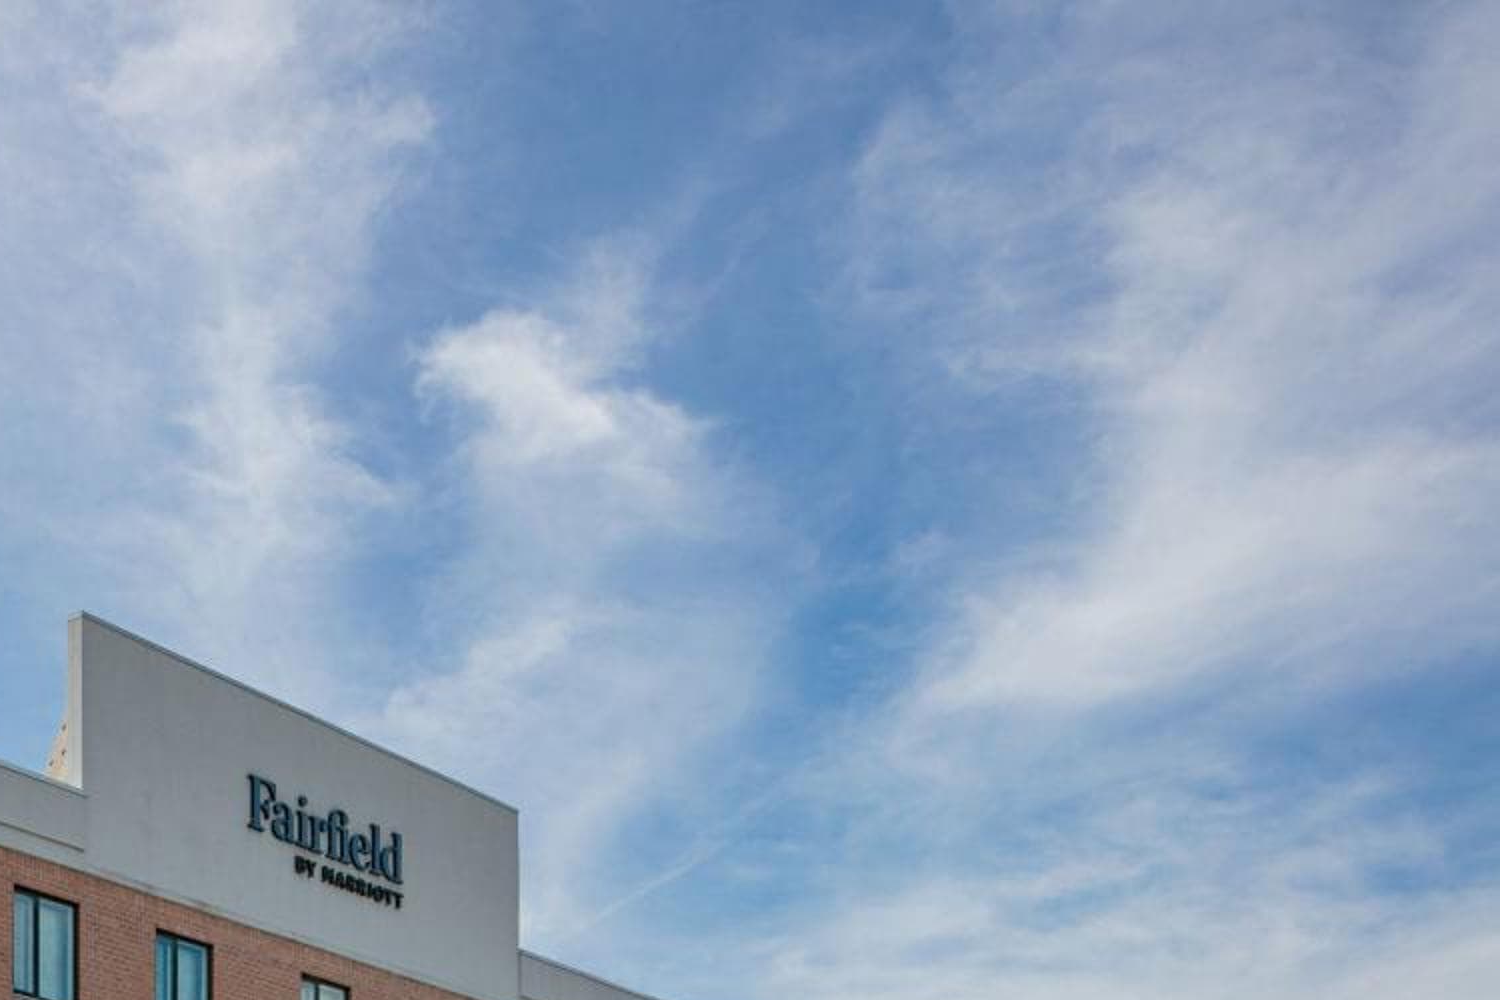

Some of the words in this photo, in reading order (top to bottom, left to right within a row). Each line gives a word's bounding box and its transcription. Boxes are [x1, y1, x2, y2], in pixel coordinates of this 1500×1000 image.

[247, 774, 403, 885] Fairfield
[294, 855, 316, 878] BY
[321, 865, 404, 910] MARRIOTT
